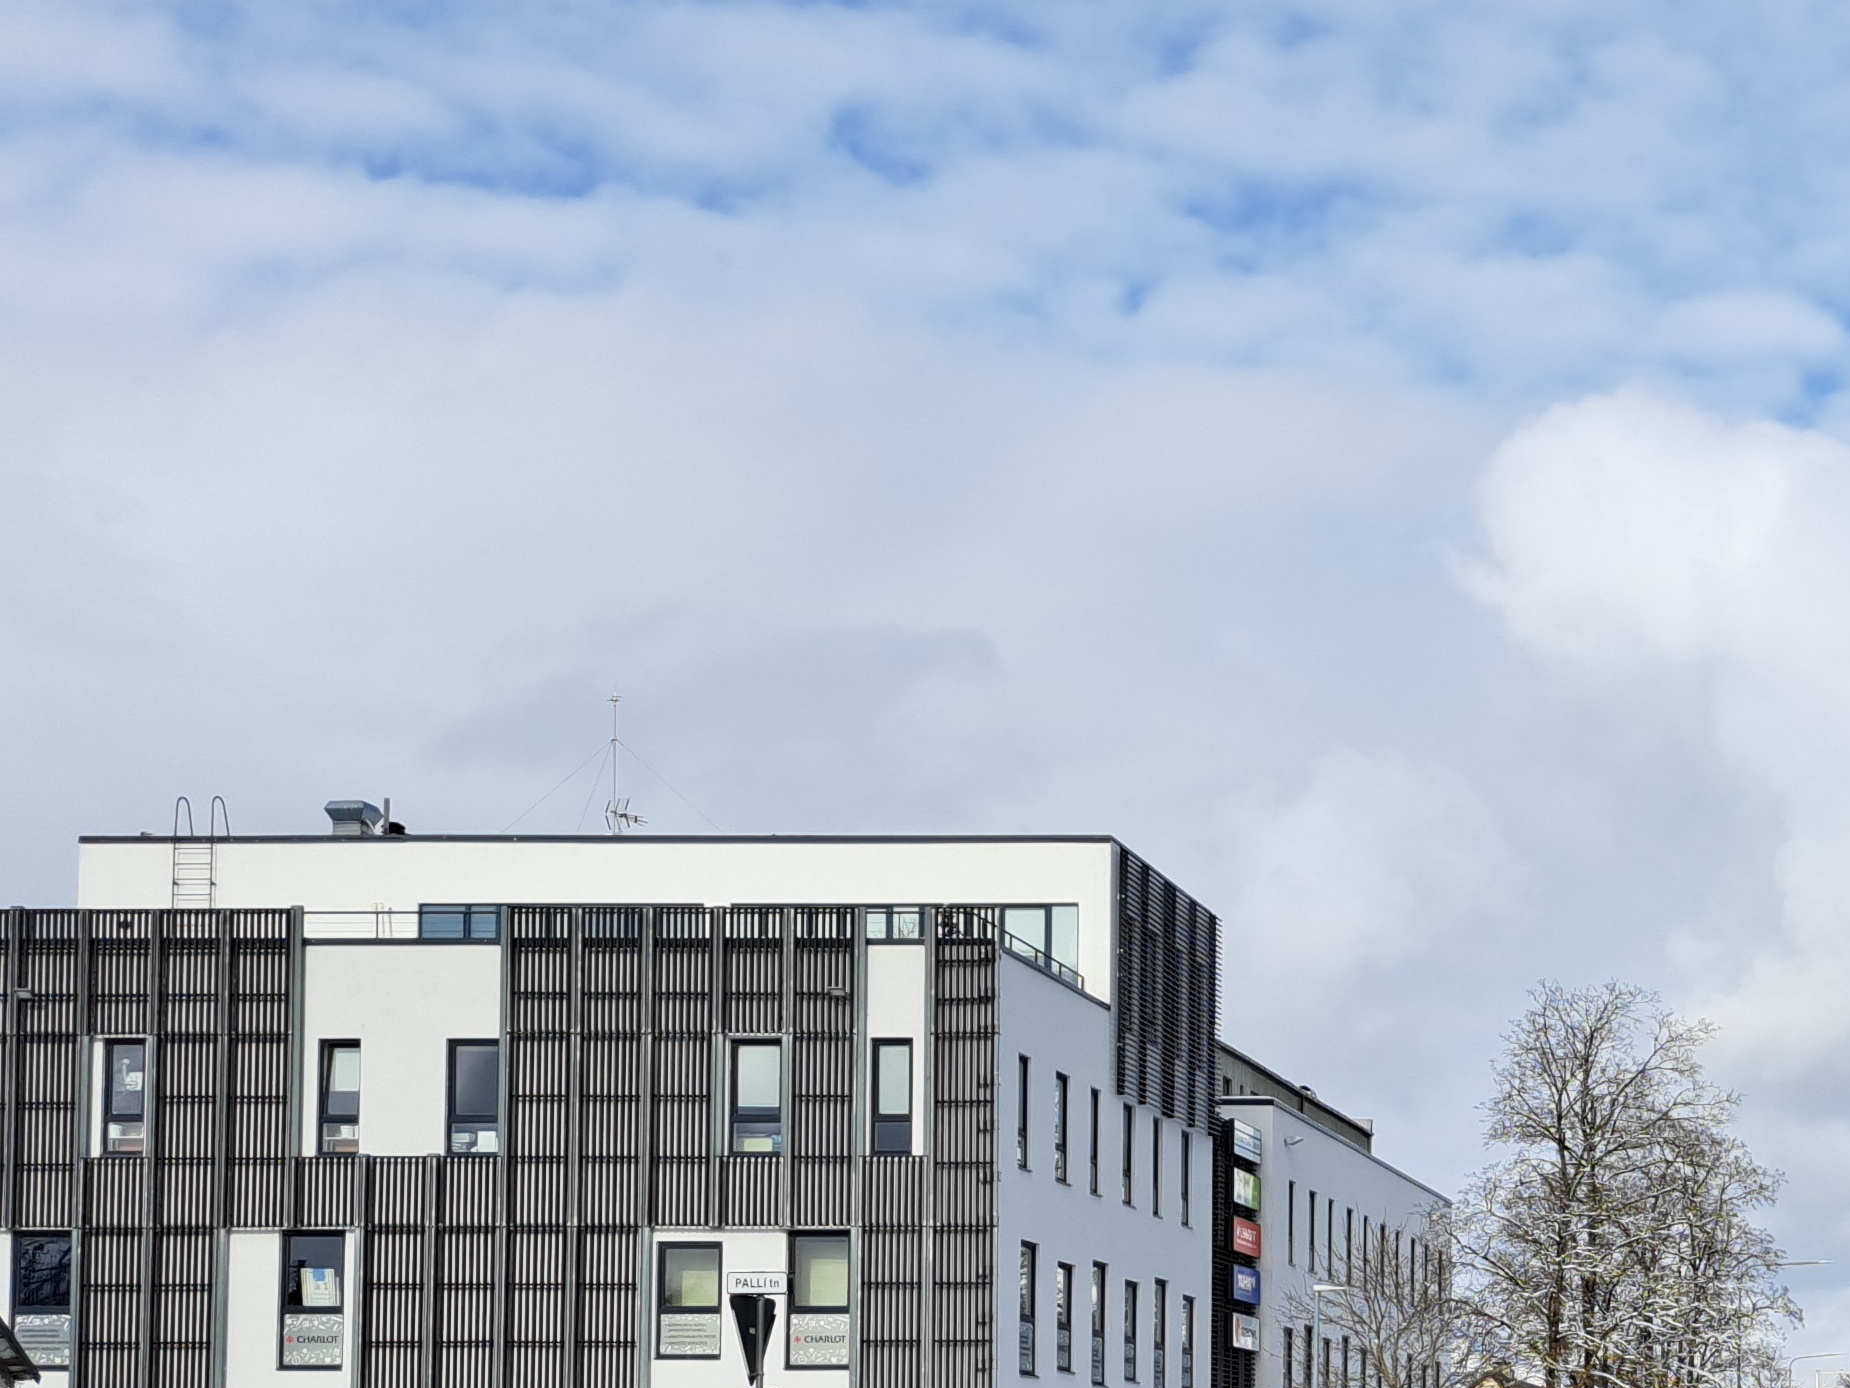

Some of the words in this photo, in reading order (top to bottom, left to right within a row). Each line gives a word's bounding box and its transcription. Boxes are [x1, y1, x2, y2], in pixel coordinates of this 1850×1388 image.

[769, 1278, 780, 1288] tn
[296, 1335, 339, 1344] CHARLOT
[803, 1335, 847, 1344] CHARLOT
